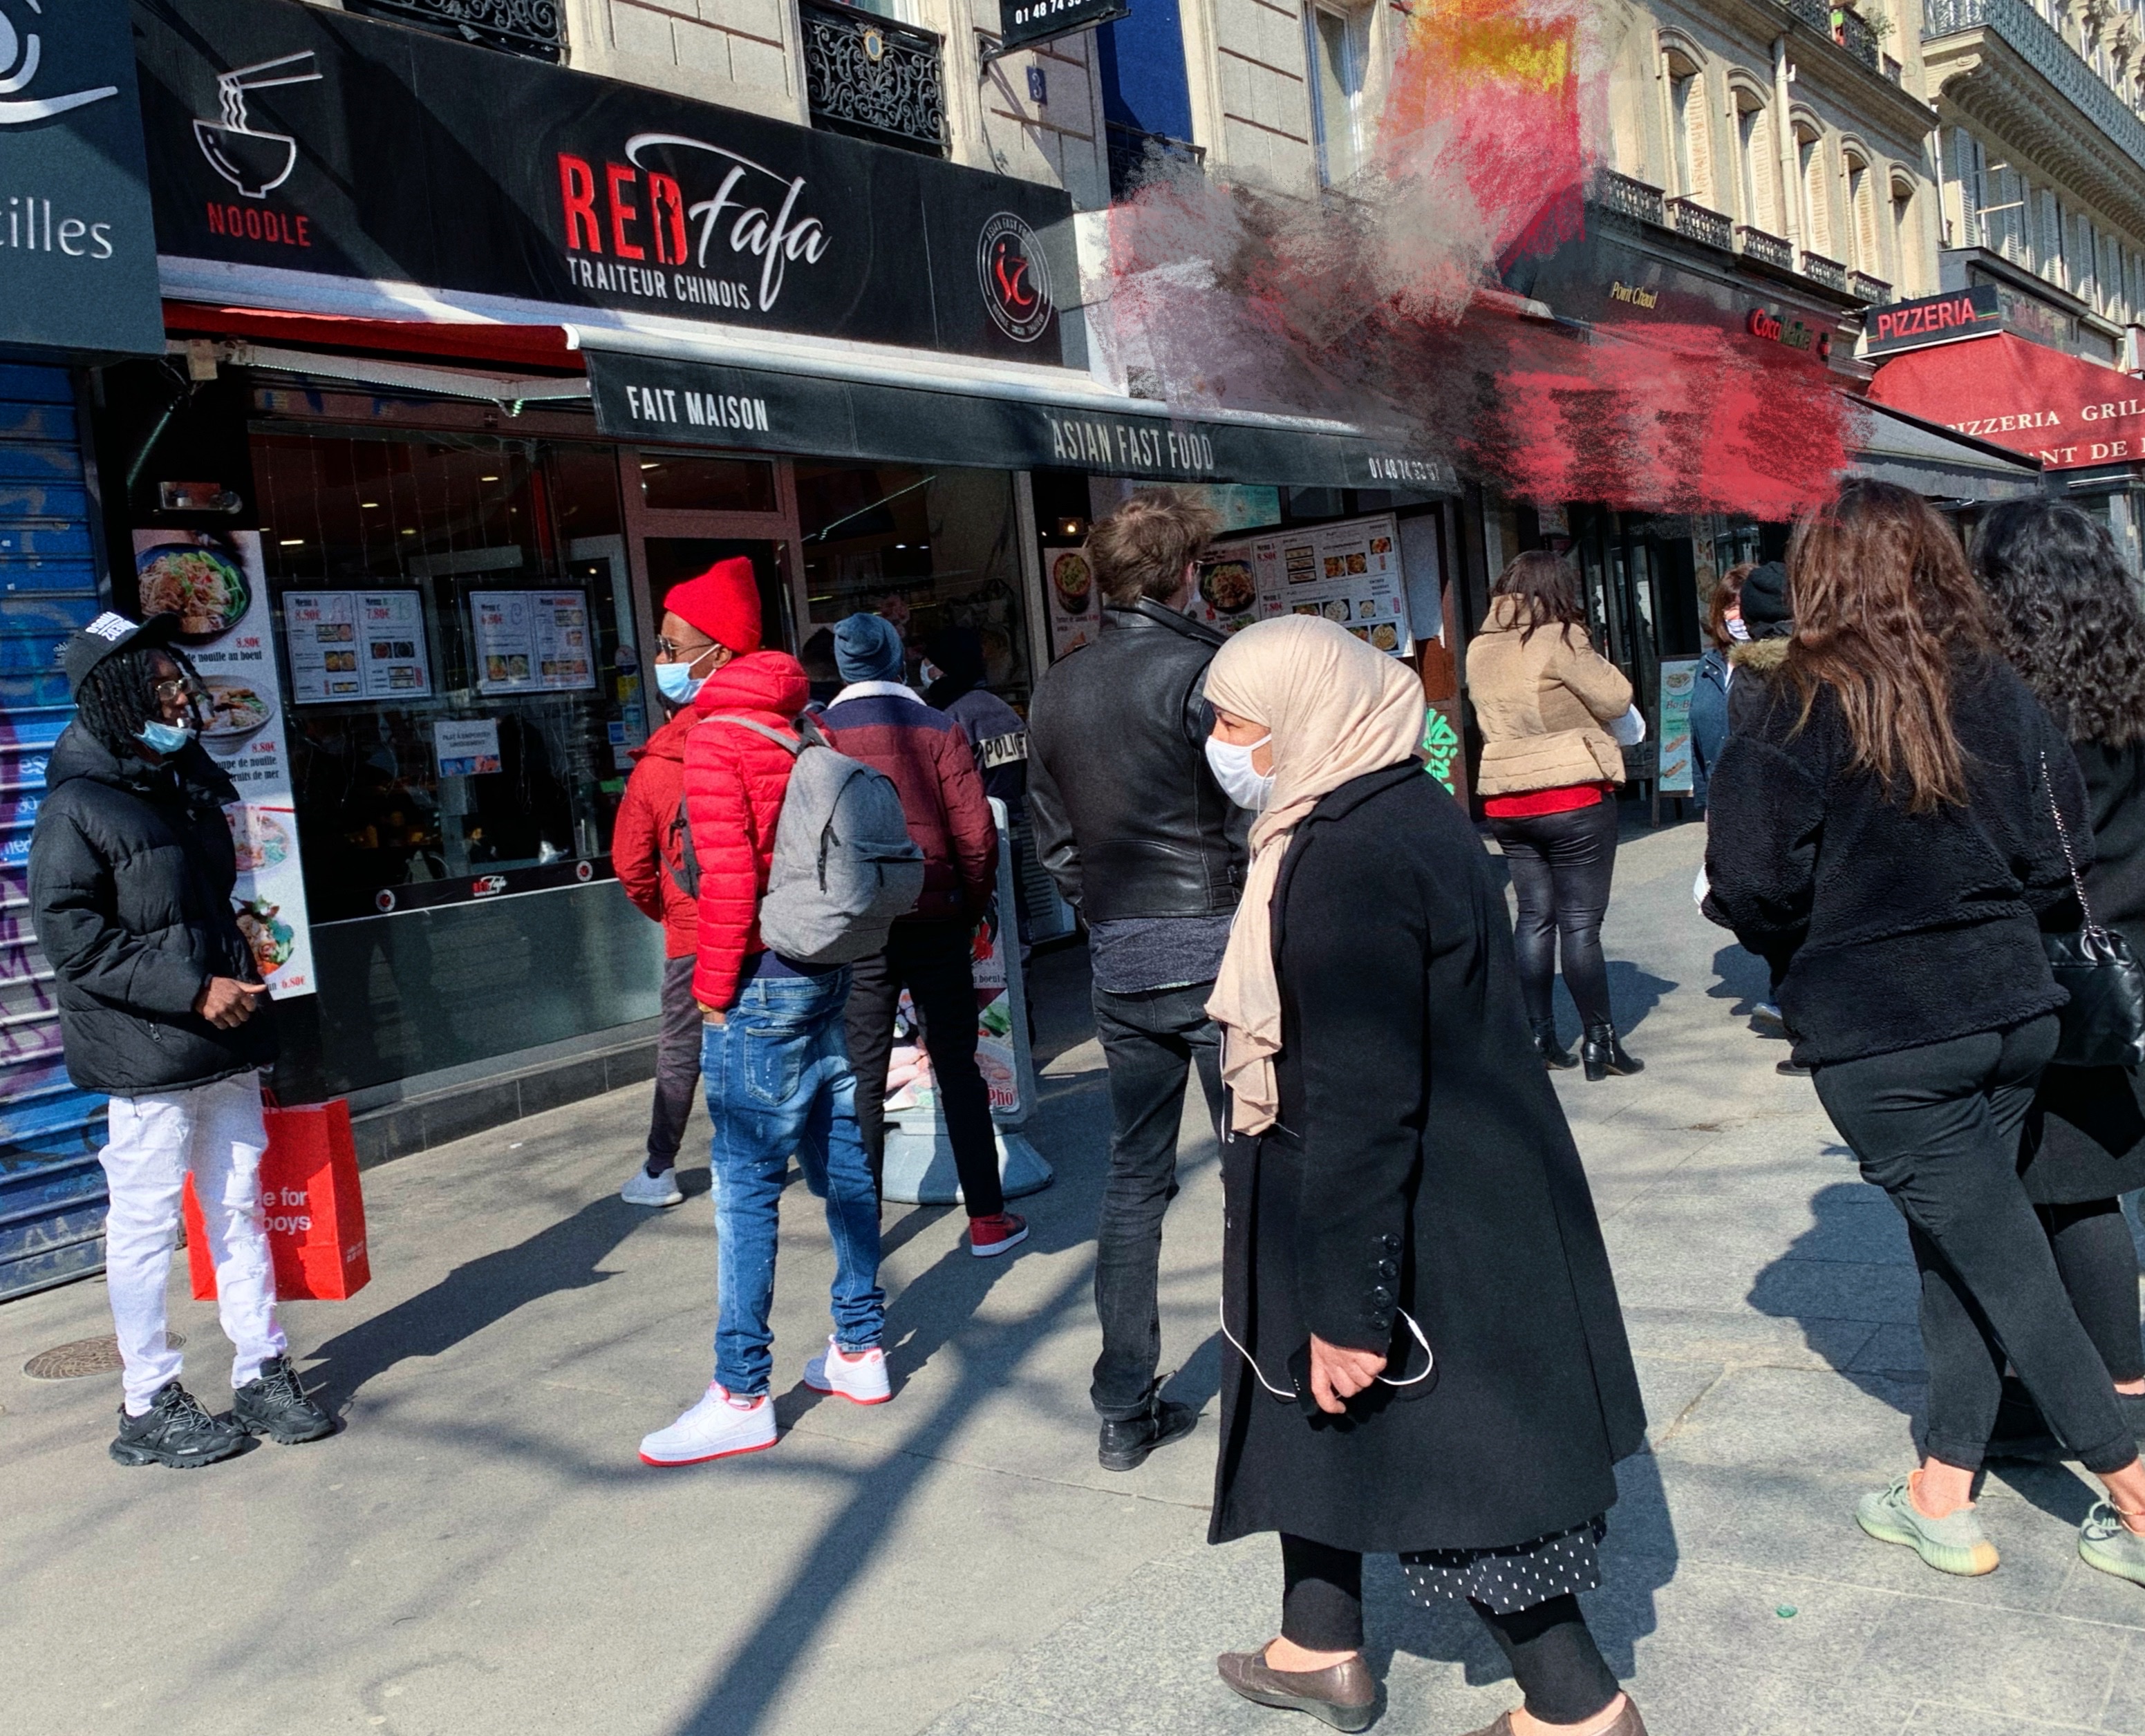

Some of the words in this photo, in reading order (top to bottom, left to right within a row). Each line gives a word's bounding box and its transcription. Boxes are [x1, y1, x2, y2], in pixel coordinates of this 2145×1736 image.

[1015, 8, 1029, 24] 01
[1033, 2, 1047, 18] 48
[1051, 0, 1065, 13] 74
[1032, 72, 1042, 99] 3
[557, 152, 689, 266] RED
[0, 196, 113, 259] illes
[207, 202, 312, 247] NOODLE
[985, 218, 1003, 242] ASIAN
[567, 257, 668, 299] TRAITEUR
[674, 273, 751, 311] CHINOIS
[1611, 281, 1632, 303] Point
[1632, 286, 1658, 309] Chaud
[1877, 297, 1976, 340] PIZZERIA
[626, 386, 677, 423] FAIT
[685, 391, 769, 431] MAISON
[2081, 399, 2145, 422] GRIL
[1051, 418, 1112, 463] ASIAN
[1116, 424, 1161, 467] FAST
[1167, 430, 1215, 471] FOOD
[2027, 446, 2078, 466] NT
[2090, 440, 2128, 460] DE
[1368, 457, 1383, 479] 01
[1385, 458, 1398, 480] 48
[1397, 458, 1414, 480] 74
[217, 761, 236, 770] oupe
[238, 758, 248, 768] de
[281, 1187, 307, 1206] for
